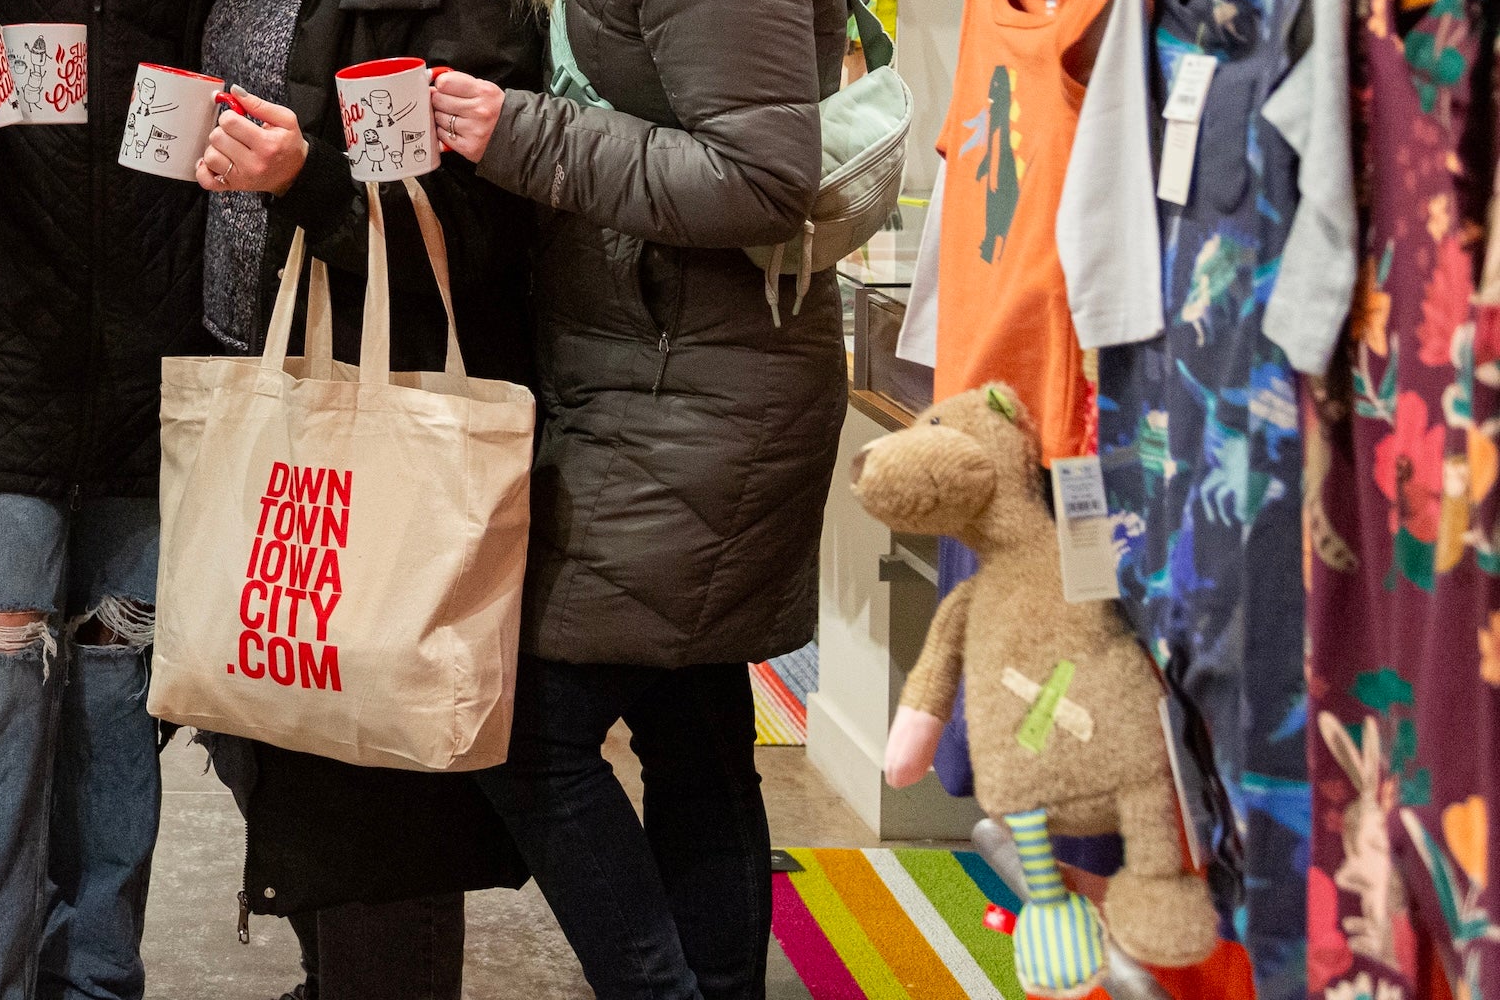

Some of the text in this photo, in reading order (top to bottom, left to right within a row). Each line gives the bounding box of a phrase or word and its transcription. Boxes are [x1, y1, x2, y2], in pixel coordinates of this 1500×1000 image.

[246, 536, 342, 593] IOWA
[239, 579, 342, 641] CITY
[227, 629, 342, 692] .COM
